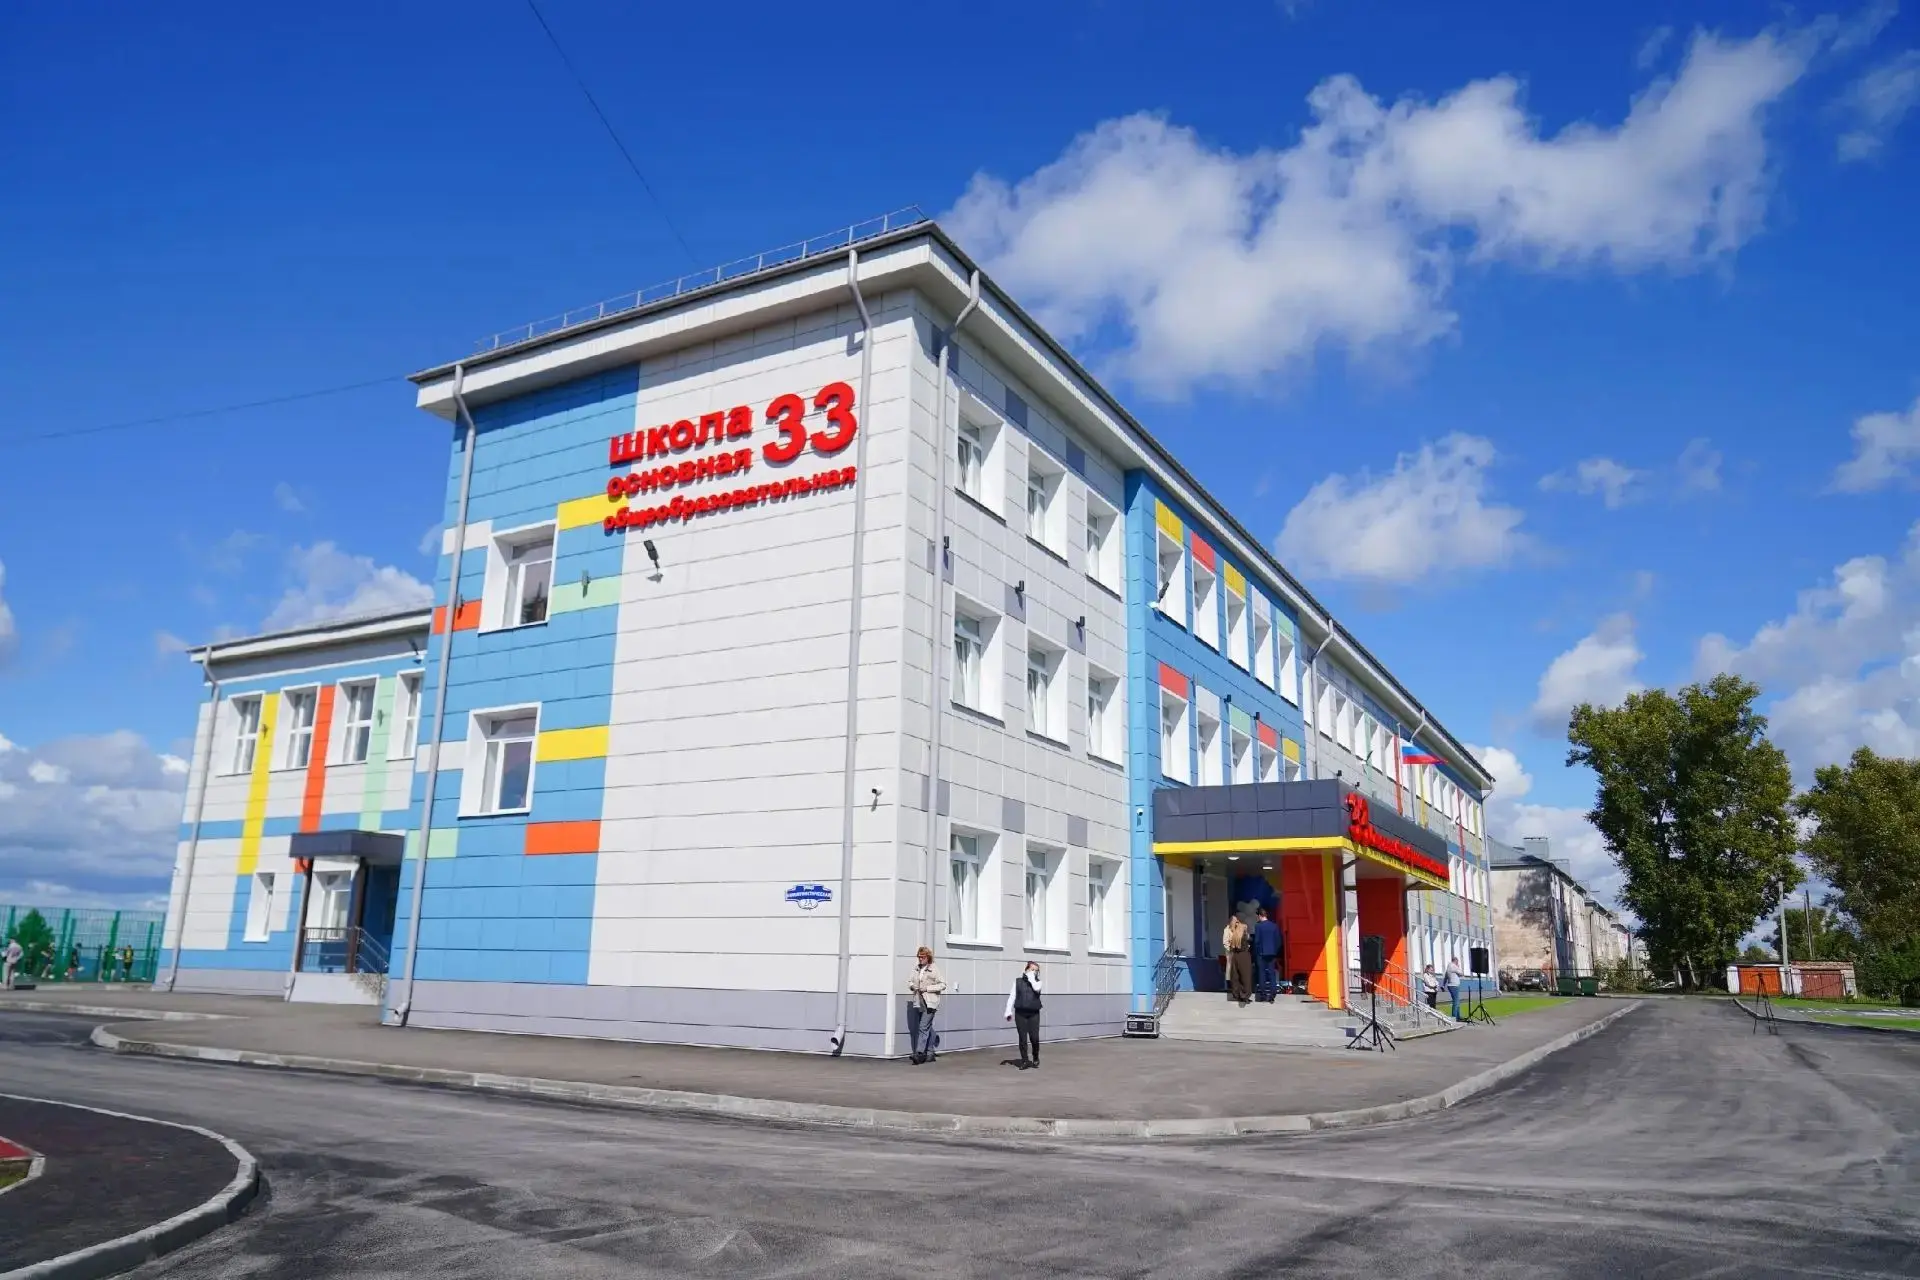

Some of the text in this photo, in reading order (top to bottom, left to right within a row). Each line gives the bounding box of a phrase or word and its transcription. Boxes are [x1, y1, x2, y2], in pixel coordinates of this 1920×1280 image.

[762, 381, 858, 462] 33
[603, 466, 857, 529] общеобразовательная
[606, 447, 753, 498] основная
